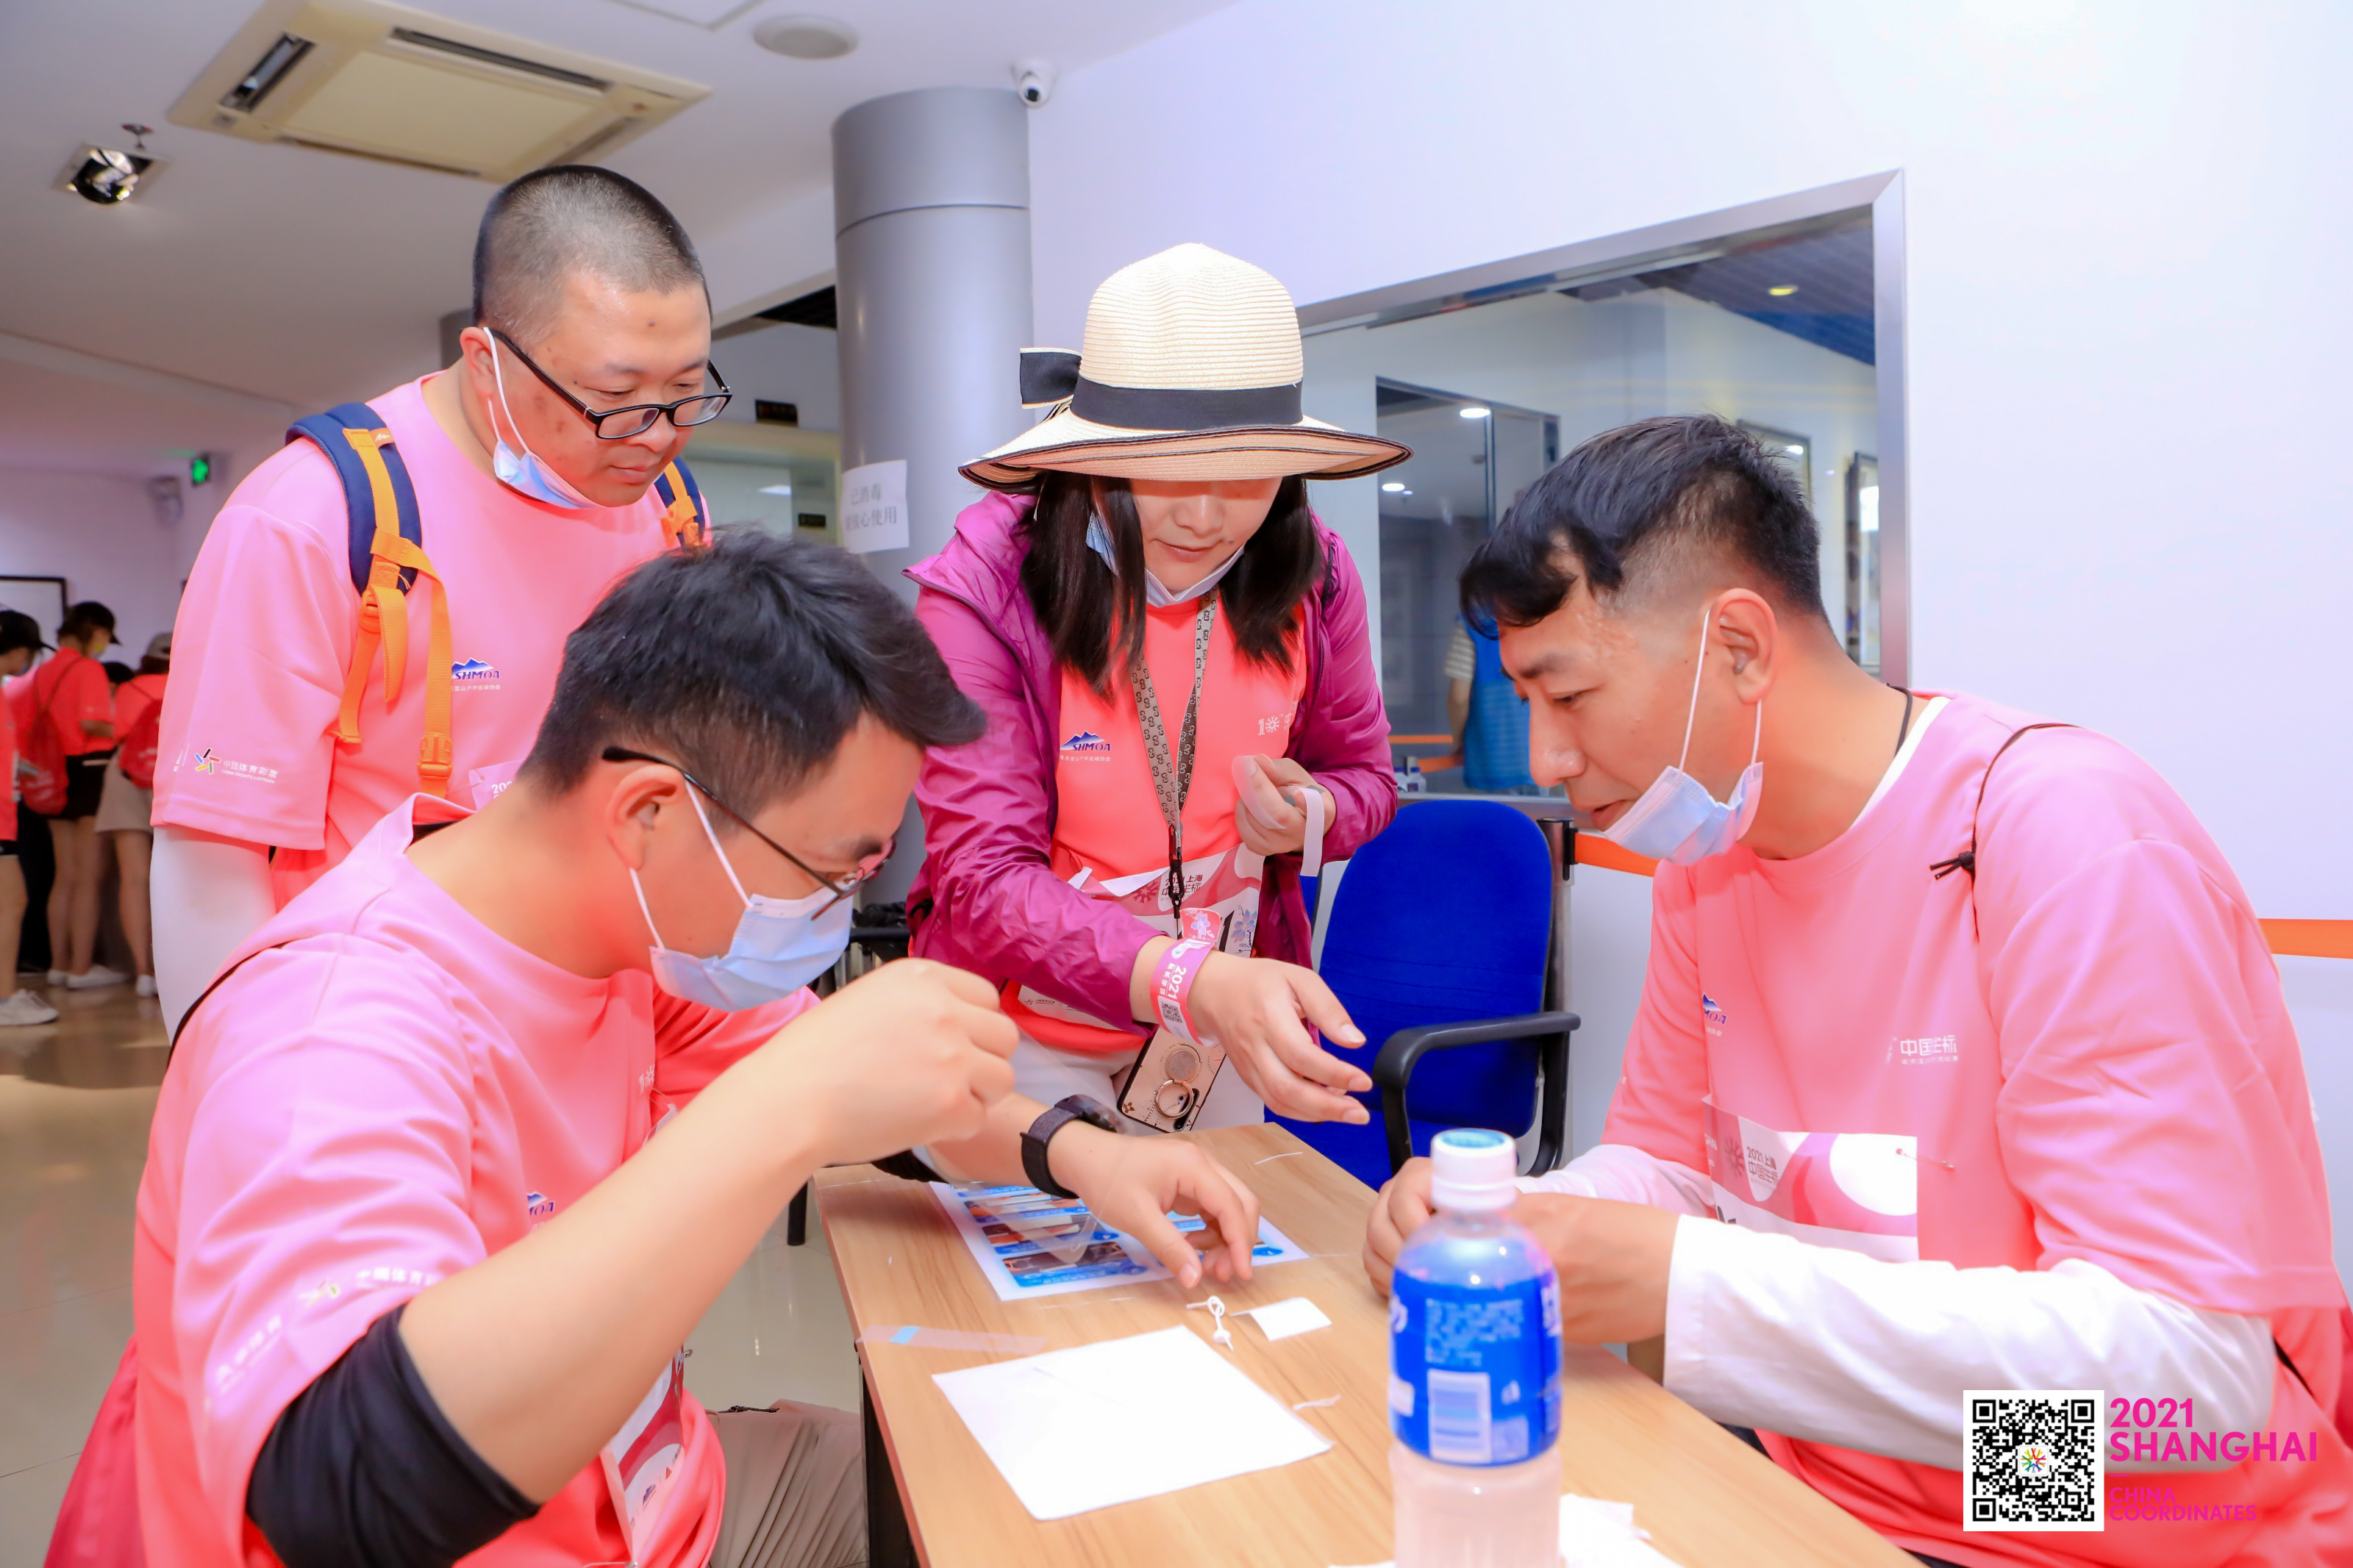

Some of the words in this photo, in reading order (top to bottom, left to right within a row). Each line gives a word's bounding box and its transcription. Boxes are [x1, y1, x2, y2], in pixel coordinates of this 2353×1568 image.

[455, 670, 500, 680] SHMOA
[1073, 742, 1111, 752] SHMOA
[223, 760, 279, 778] 中国体育彩票
[1185, 874, 1204, 884] 上海
[1168, 965, 1187, 999] 2021
[1746, 1146, 1764, 1164] 2021
